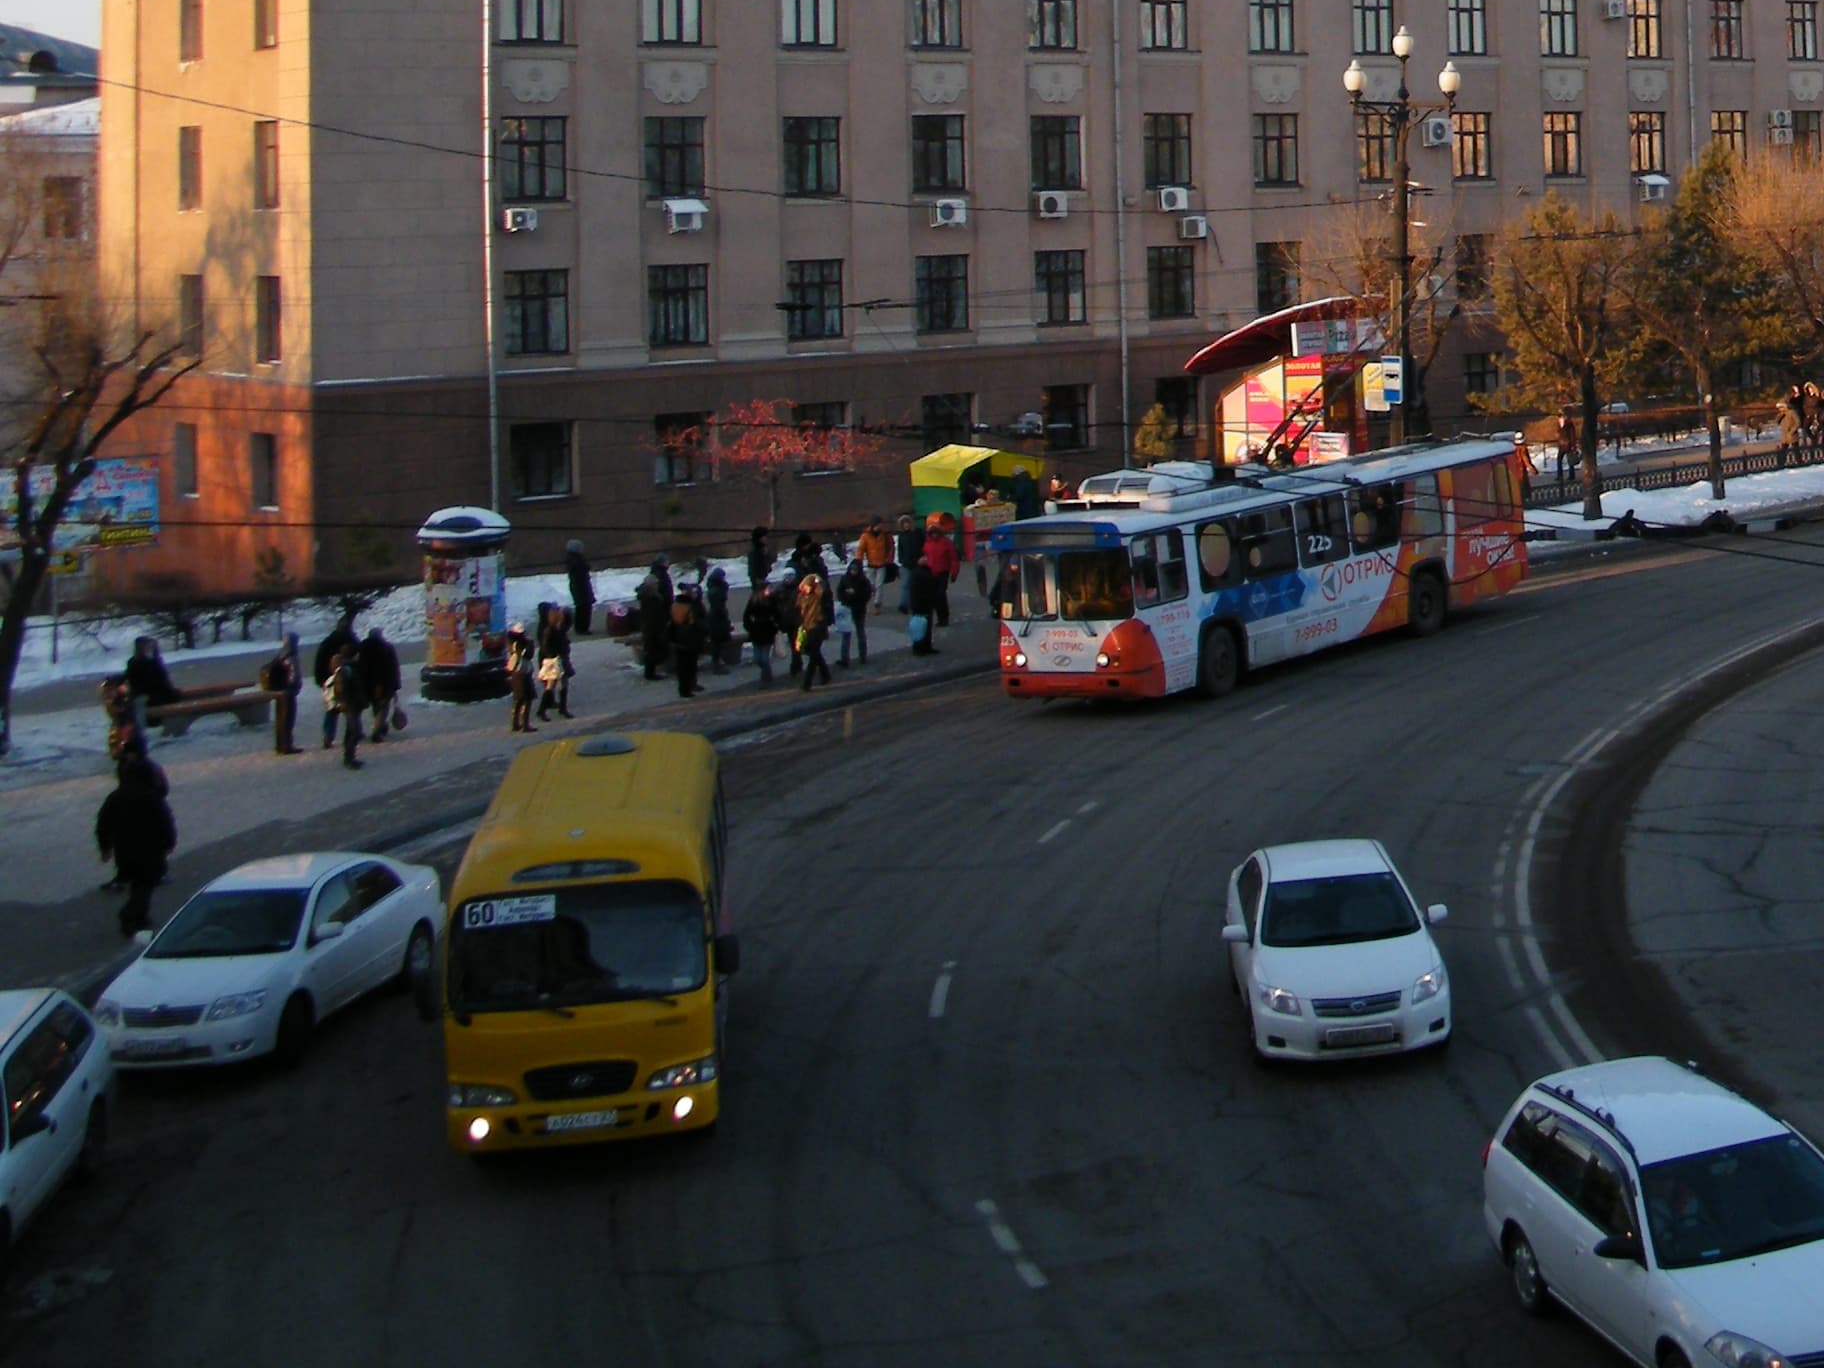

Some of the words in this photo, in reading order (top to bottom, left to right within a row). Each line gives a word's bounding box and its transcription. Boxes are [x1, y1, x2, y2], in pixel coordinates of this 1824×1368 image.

[1343, 552, 1393, 584] ОТРИС
[1052, 641, 1085, 652] ОТРИС
[467, 902, 494, 925] 60
